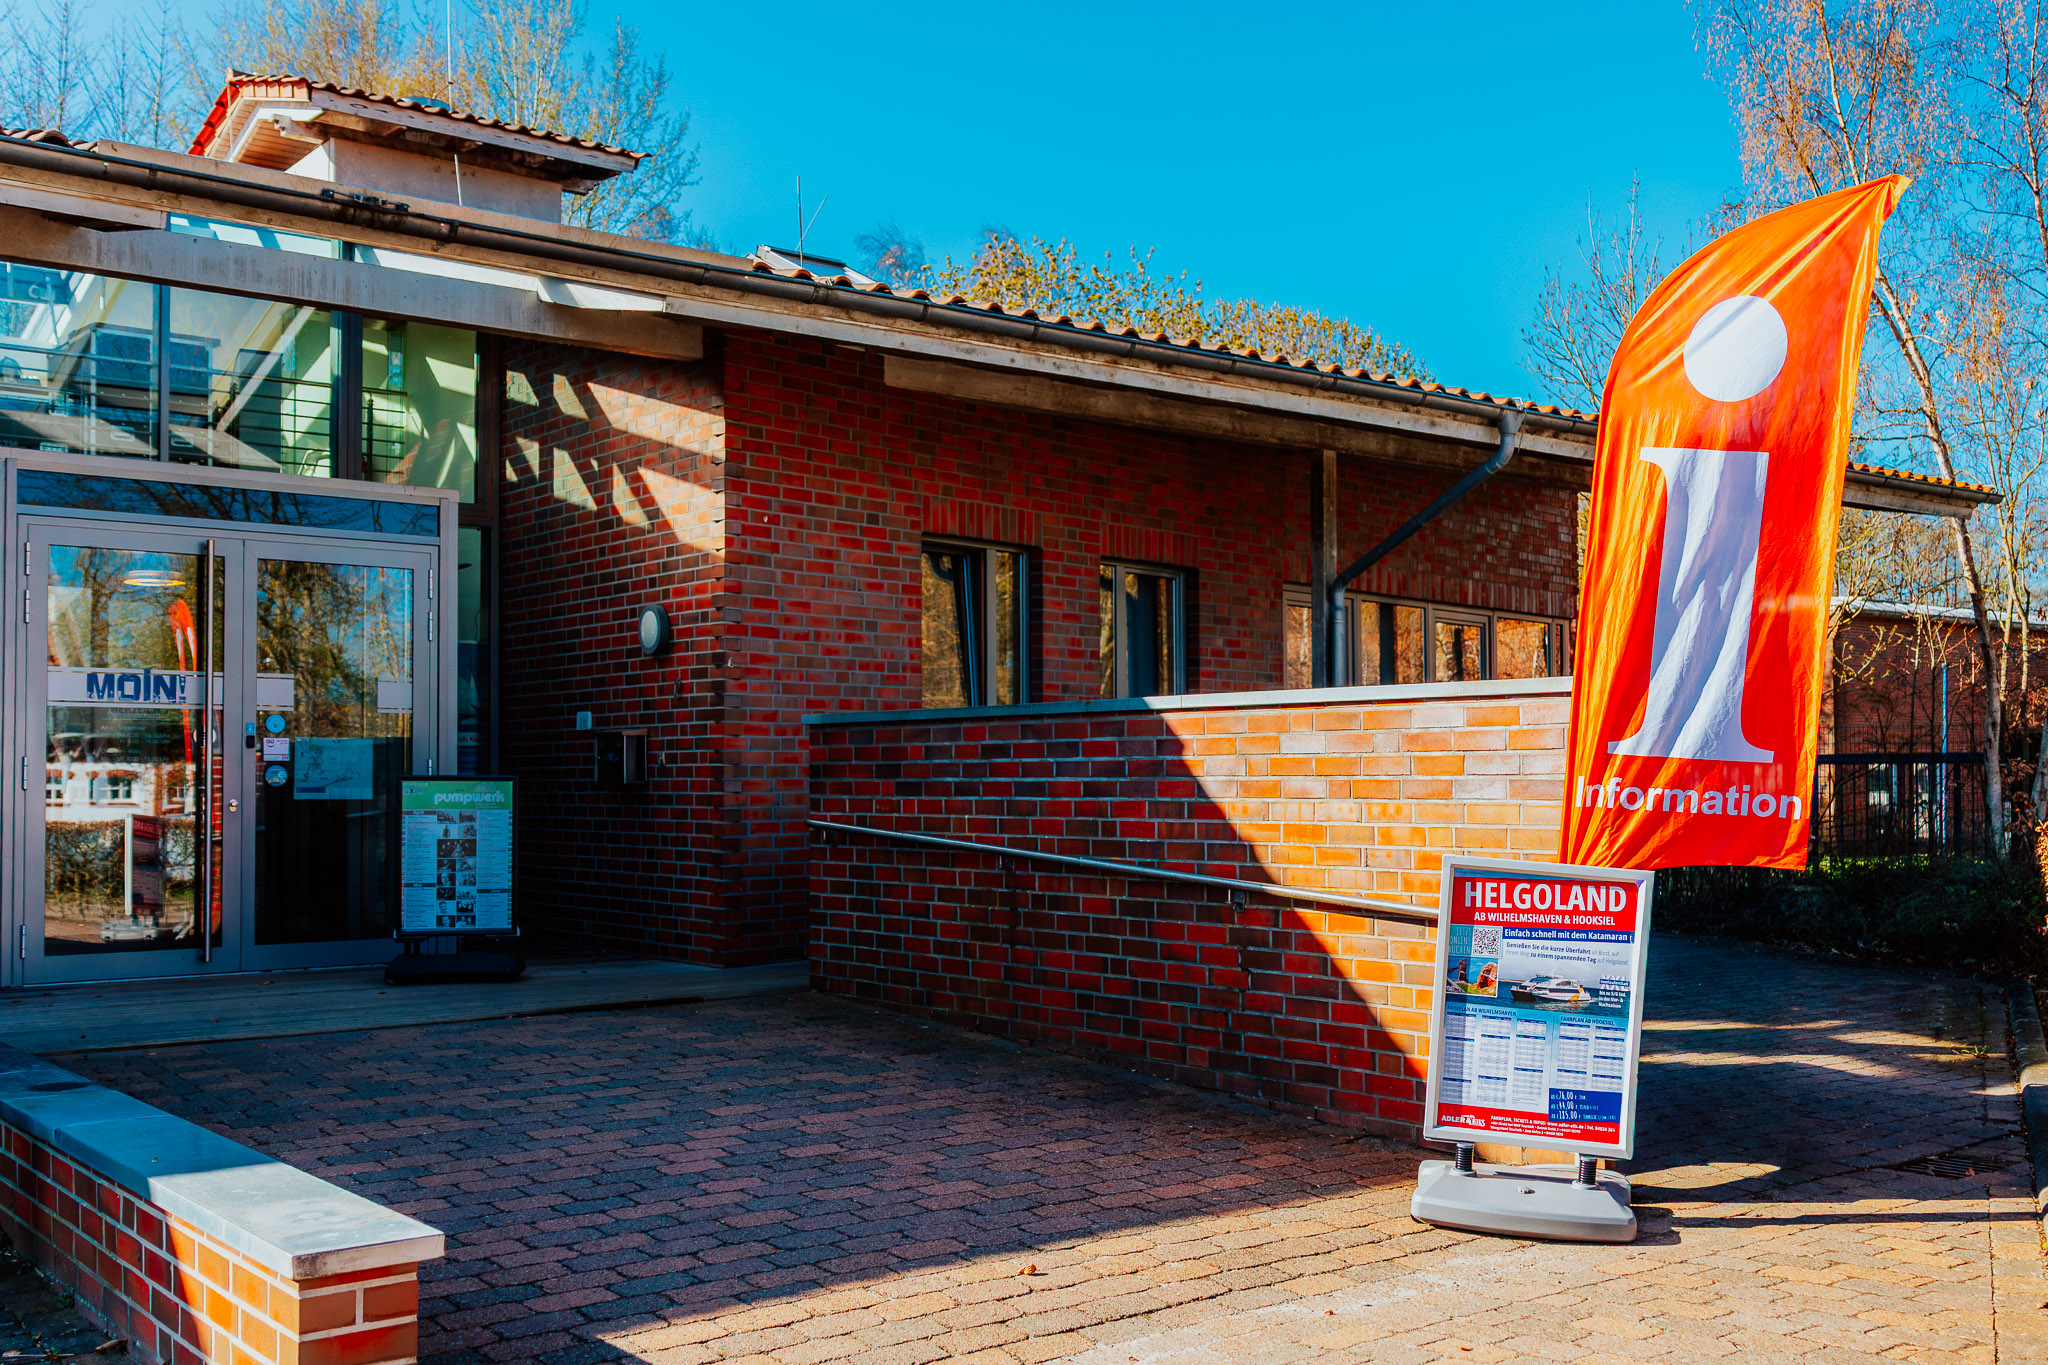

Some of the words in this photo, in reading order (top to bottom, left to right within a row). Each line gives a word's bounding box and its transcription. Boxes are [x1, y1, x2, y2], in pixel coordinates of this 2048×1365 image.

[87, 669, 186, 703] MOIN!
[434, 791, 504, 804] pumpwerk
[1576, 776, 1802, 820] Information
[1465, 882, 1627, 912] HELGOLAND
[1474, 912, 1486, 921] AB
[1487, 912, 1562, 923] WILHELMSHAVEN
[1564, 916, 1571, 924] &
[1572, 916, 1615, 926] HOOKSIEL
[1505, 929, 1530, 937] Einfach
[1532, 930, 1556, 938] schnell
[1558, 931, 1570, 939] mit
[1589, 932, 1627, 941] Katamaran
[1566, 946, 1591, 954] Überfahrt
[1554, 954, 1586, 962] spannenden
[1478, 1008, 1517, 1016] WILHELMSHAVEN
[1592, 1018, 1614, 1026] HOOKSIEL
[1441, 1115, 1465, 1123] ADLER
